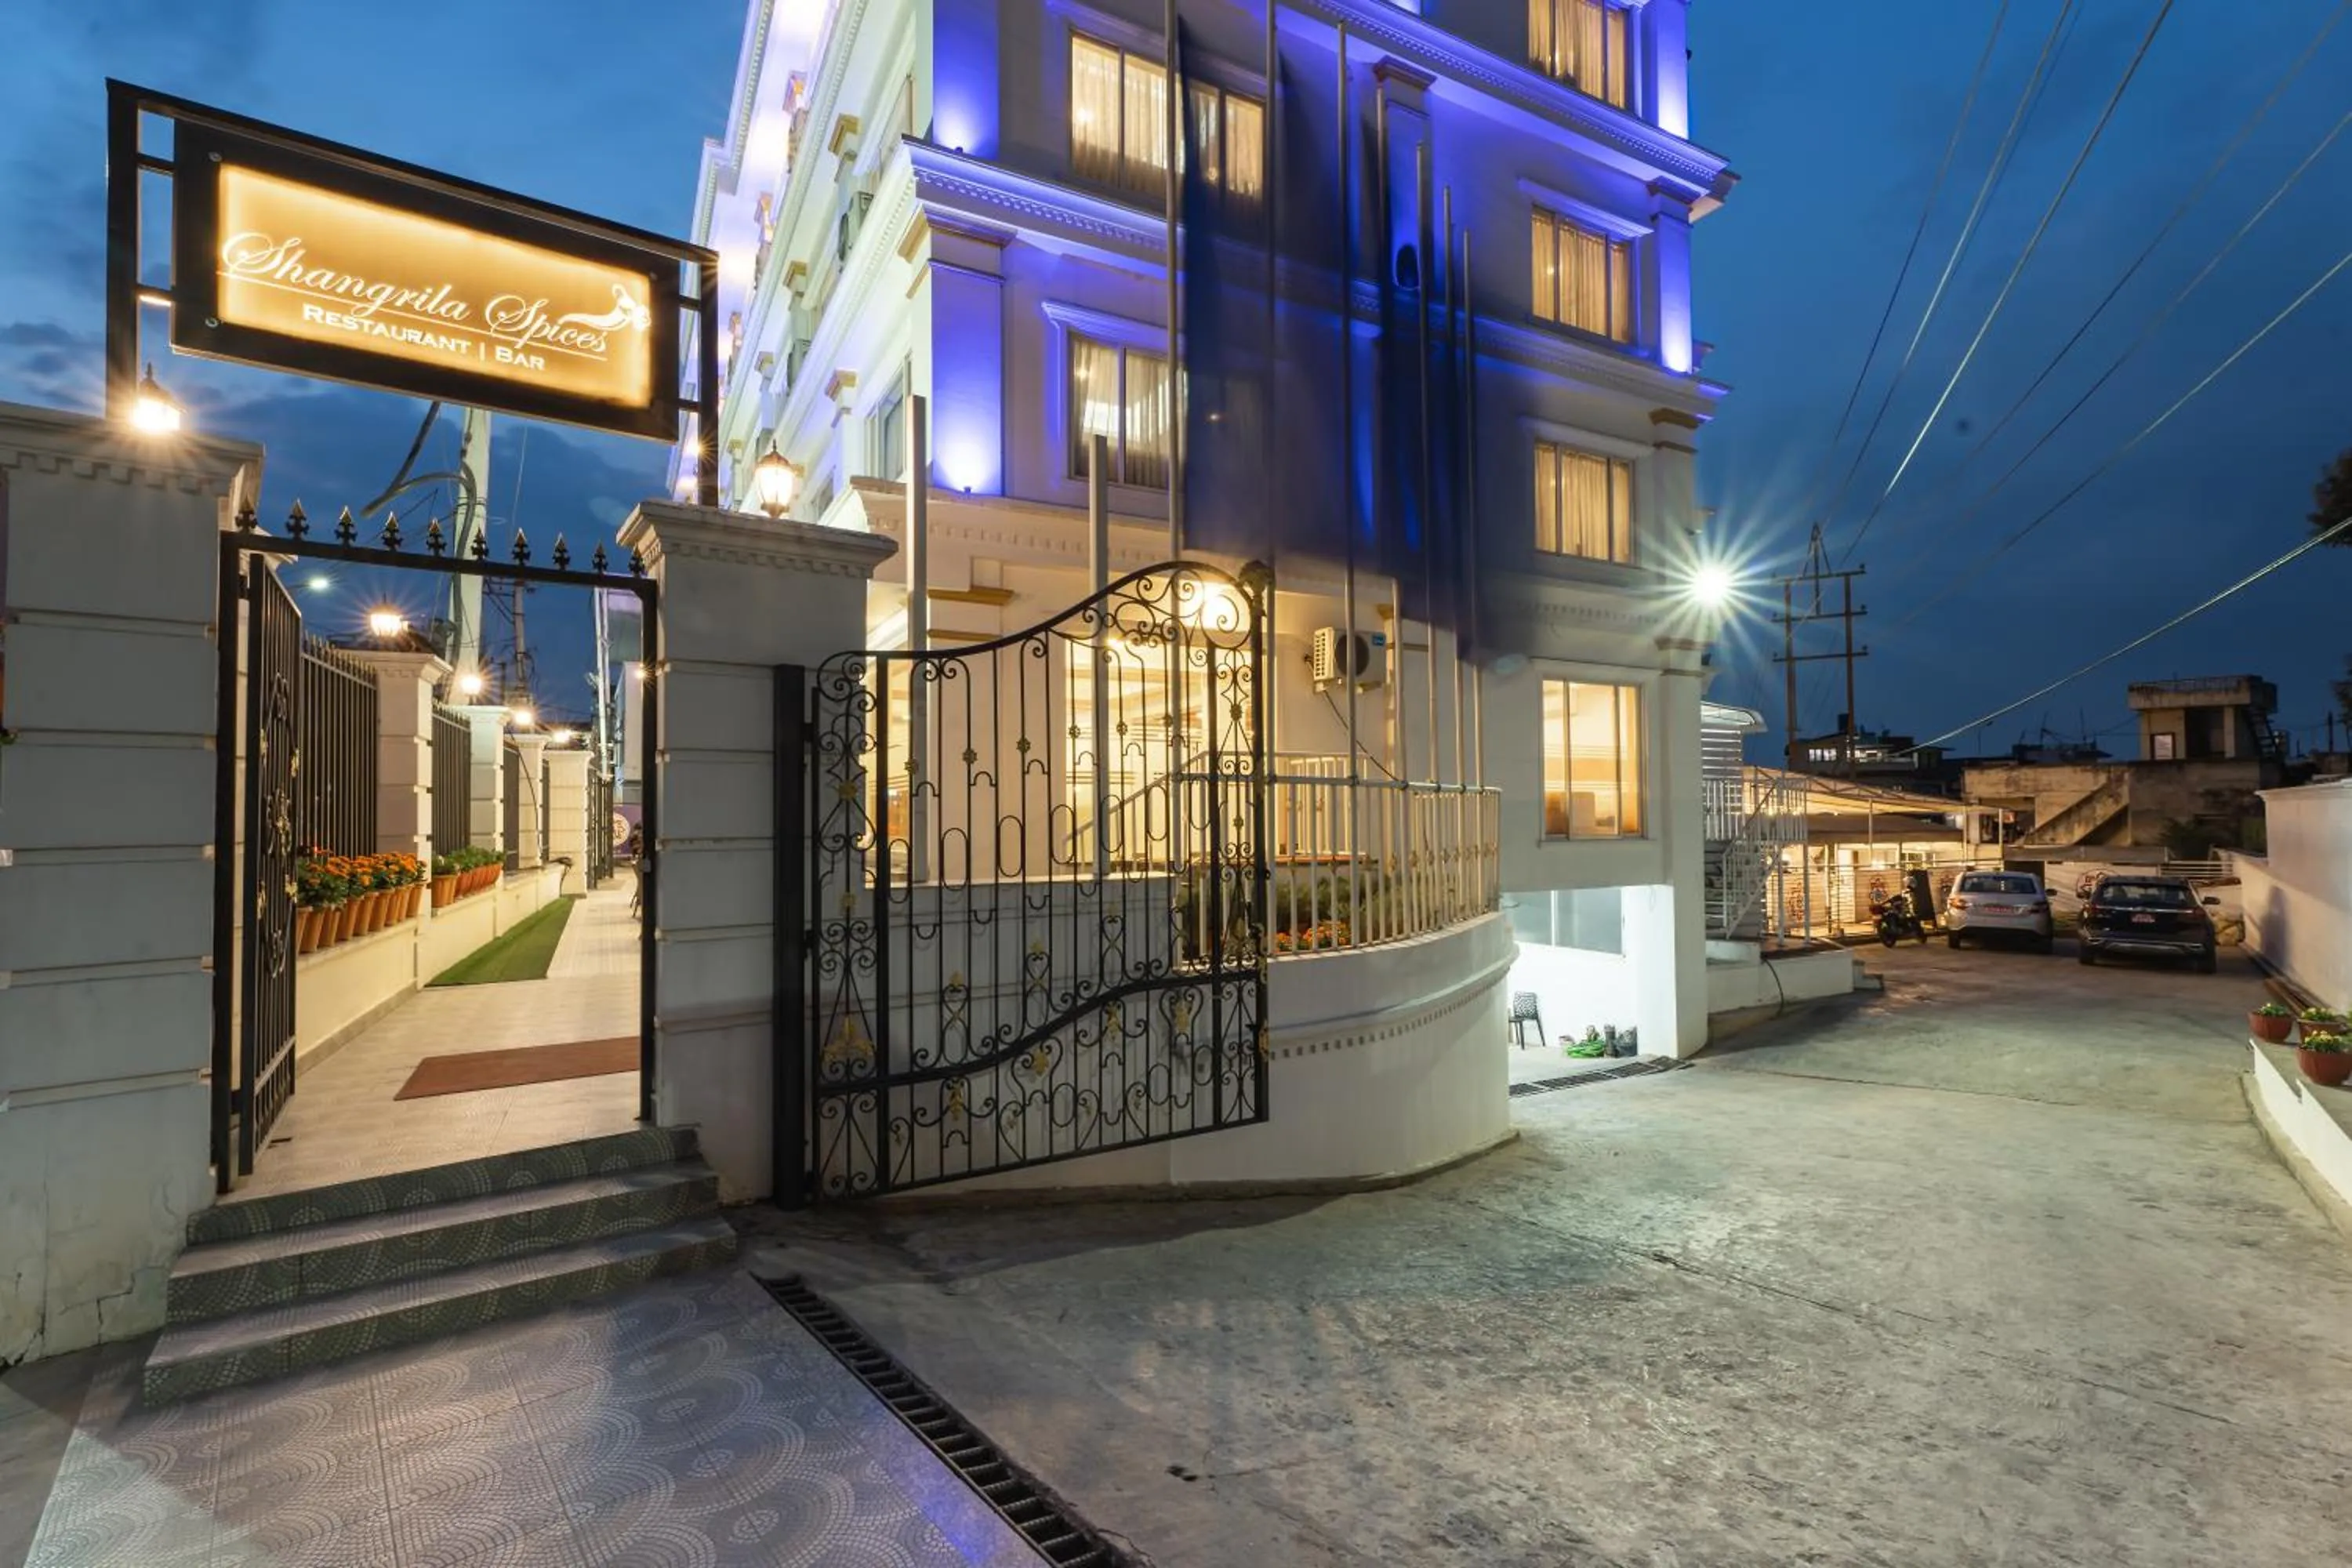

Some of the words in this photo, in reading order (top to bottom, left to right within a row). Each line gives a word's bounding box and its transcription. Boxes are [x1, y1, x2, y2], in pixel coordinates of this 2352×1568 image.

[223, 233, 471, 318] Shangrila
[485, 295, 608, 352] Spices
[303, 304, 472, 352] RESTAURANT
[495, 348, 545, 371] BAR
